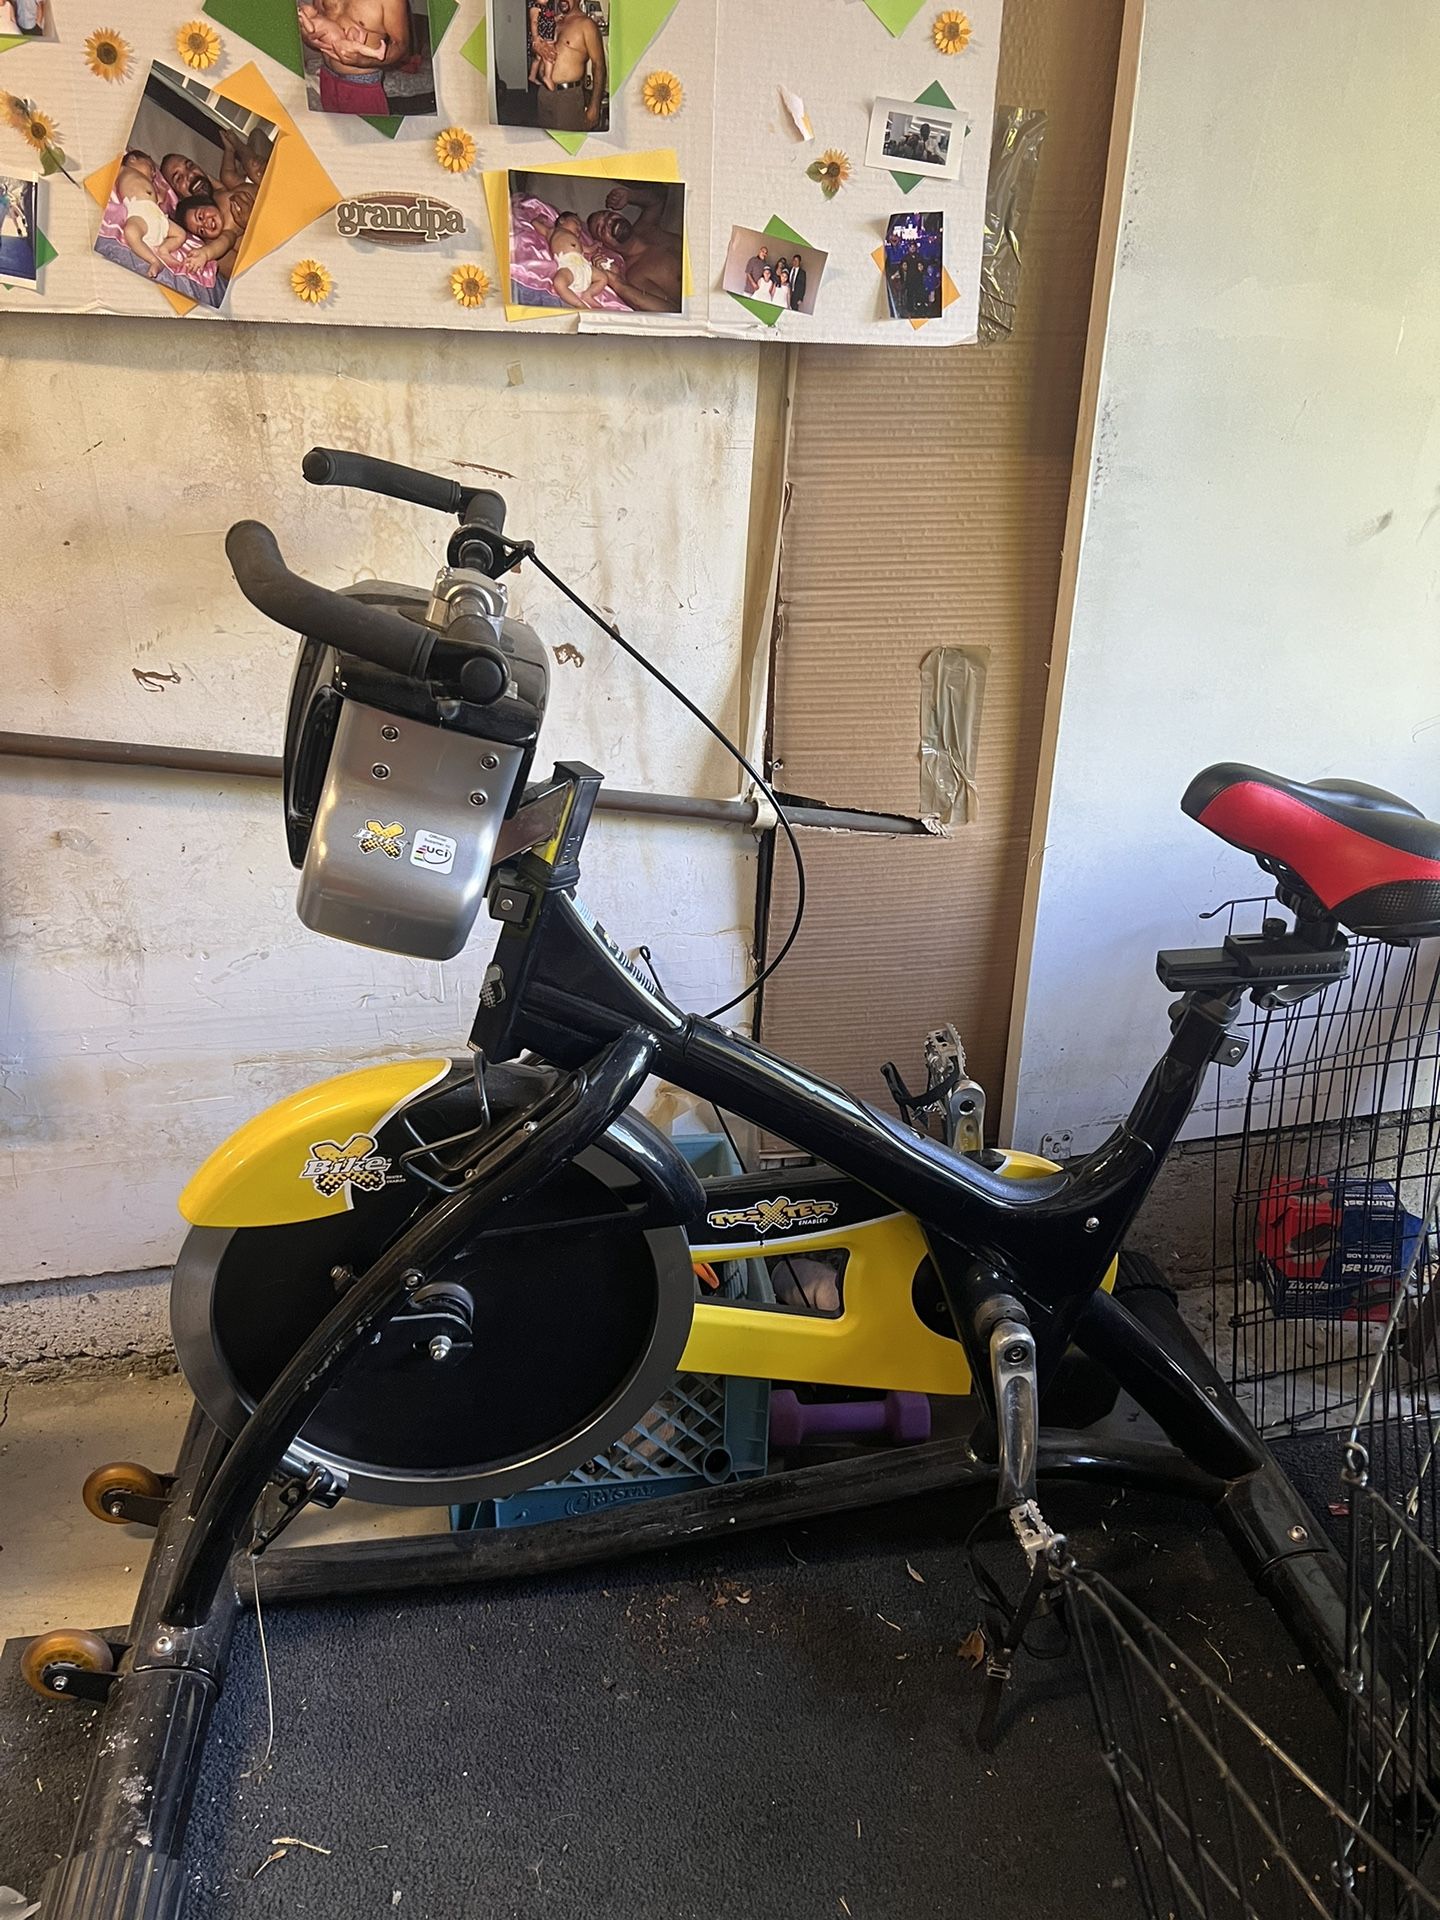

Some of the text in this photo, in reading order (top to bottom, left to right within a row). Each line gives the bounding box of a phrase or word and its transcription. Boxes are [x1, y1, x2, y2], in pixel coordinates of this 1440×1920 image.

[337, 199, 466, 239] grandpa
[300, 1156, 391, 1177] Bike
[1344, 1199, 1396, 1208] Duraast
[798, 1217, 829, 1226] ENABLED
[1341, 1263, 1393, 1274] Duraast
